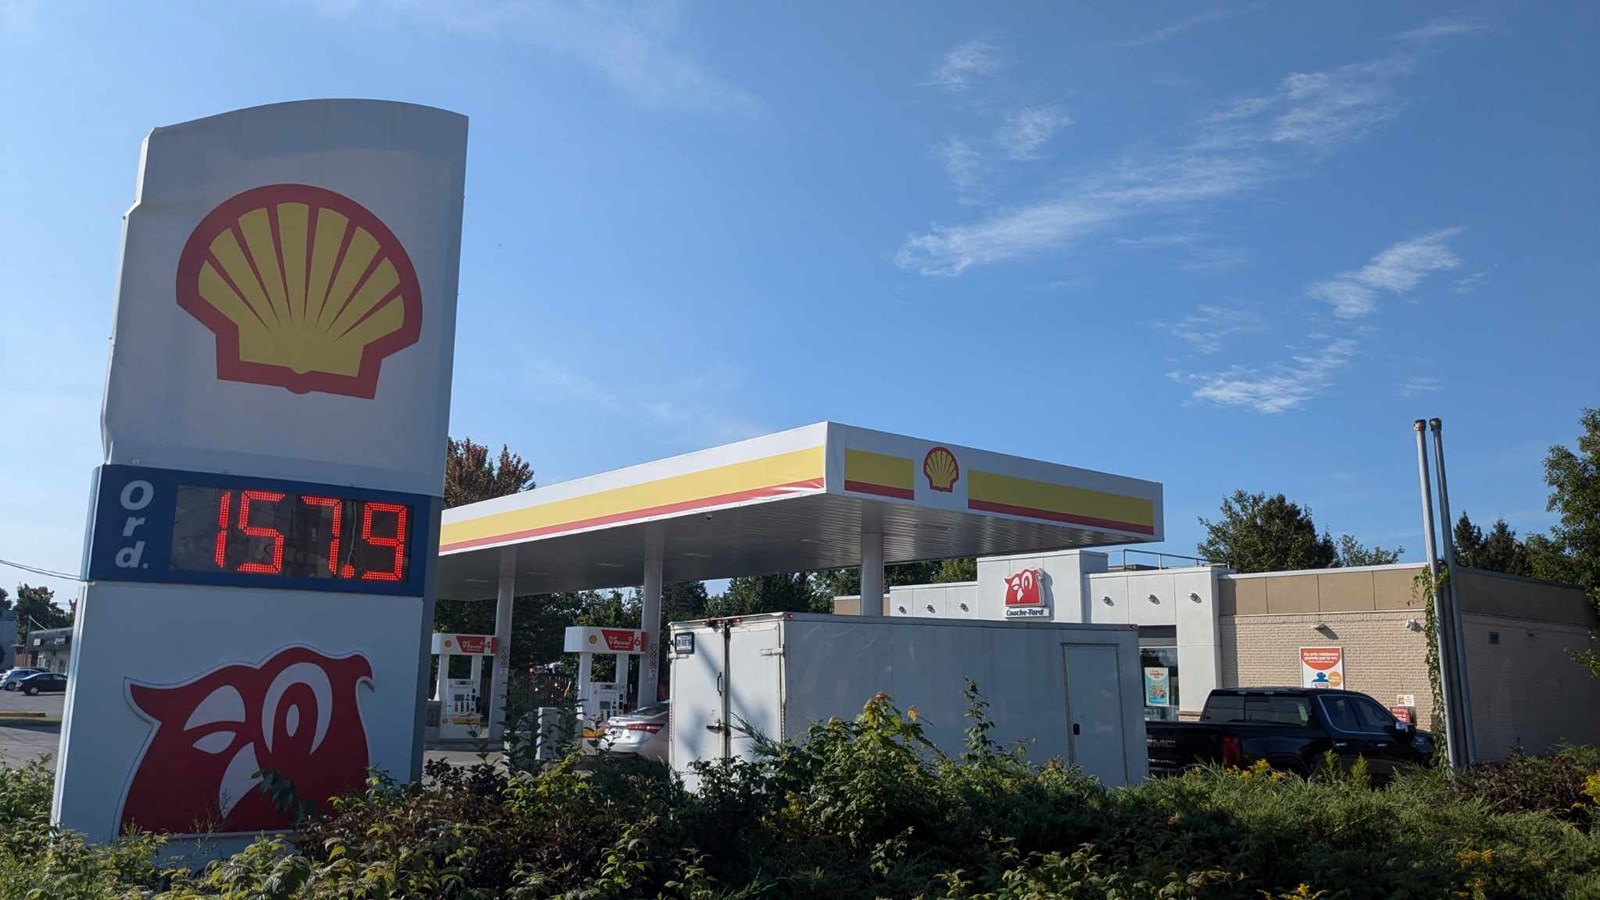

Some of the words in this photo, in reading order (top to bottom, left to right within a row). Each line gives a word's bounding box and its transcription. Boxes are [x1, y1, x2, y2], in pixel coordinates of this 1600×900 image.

[215, 490, 407, 581] 157.9
[1006, 608, 1044, 616] Couche-Tard
[485, 641, 491, 649] 4
[634, 636, 641, 646] 6
